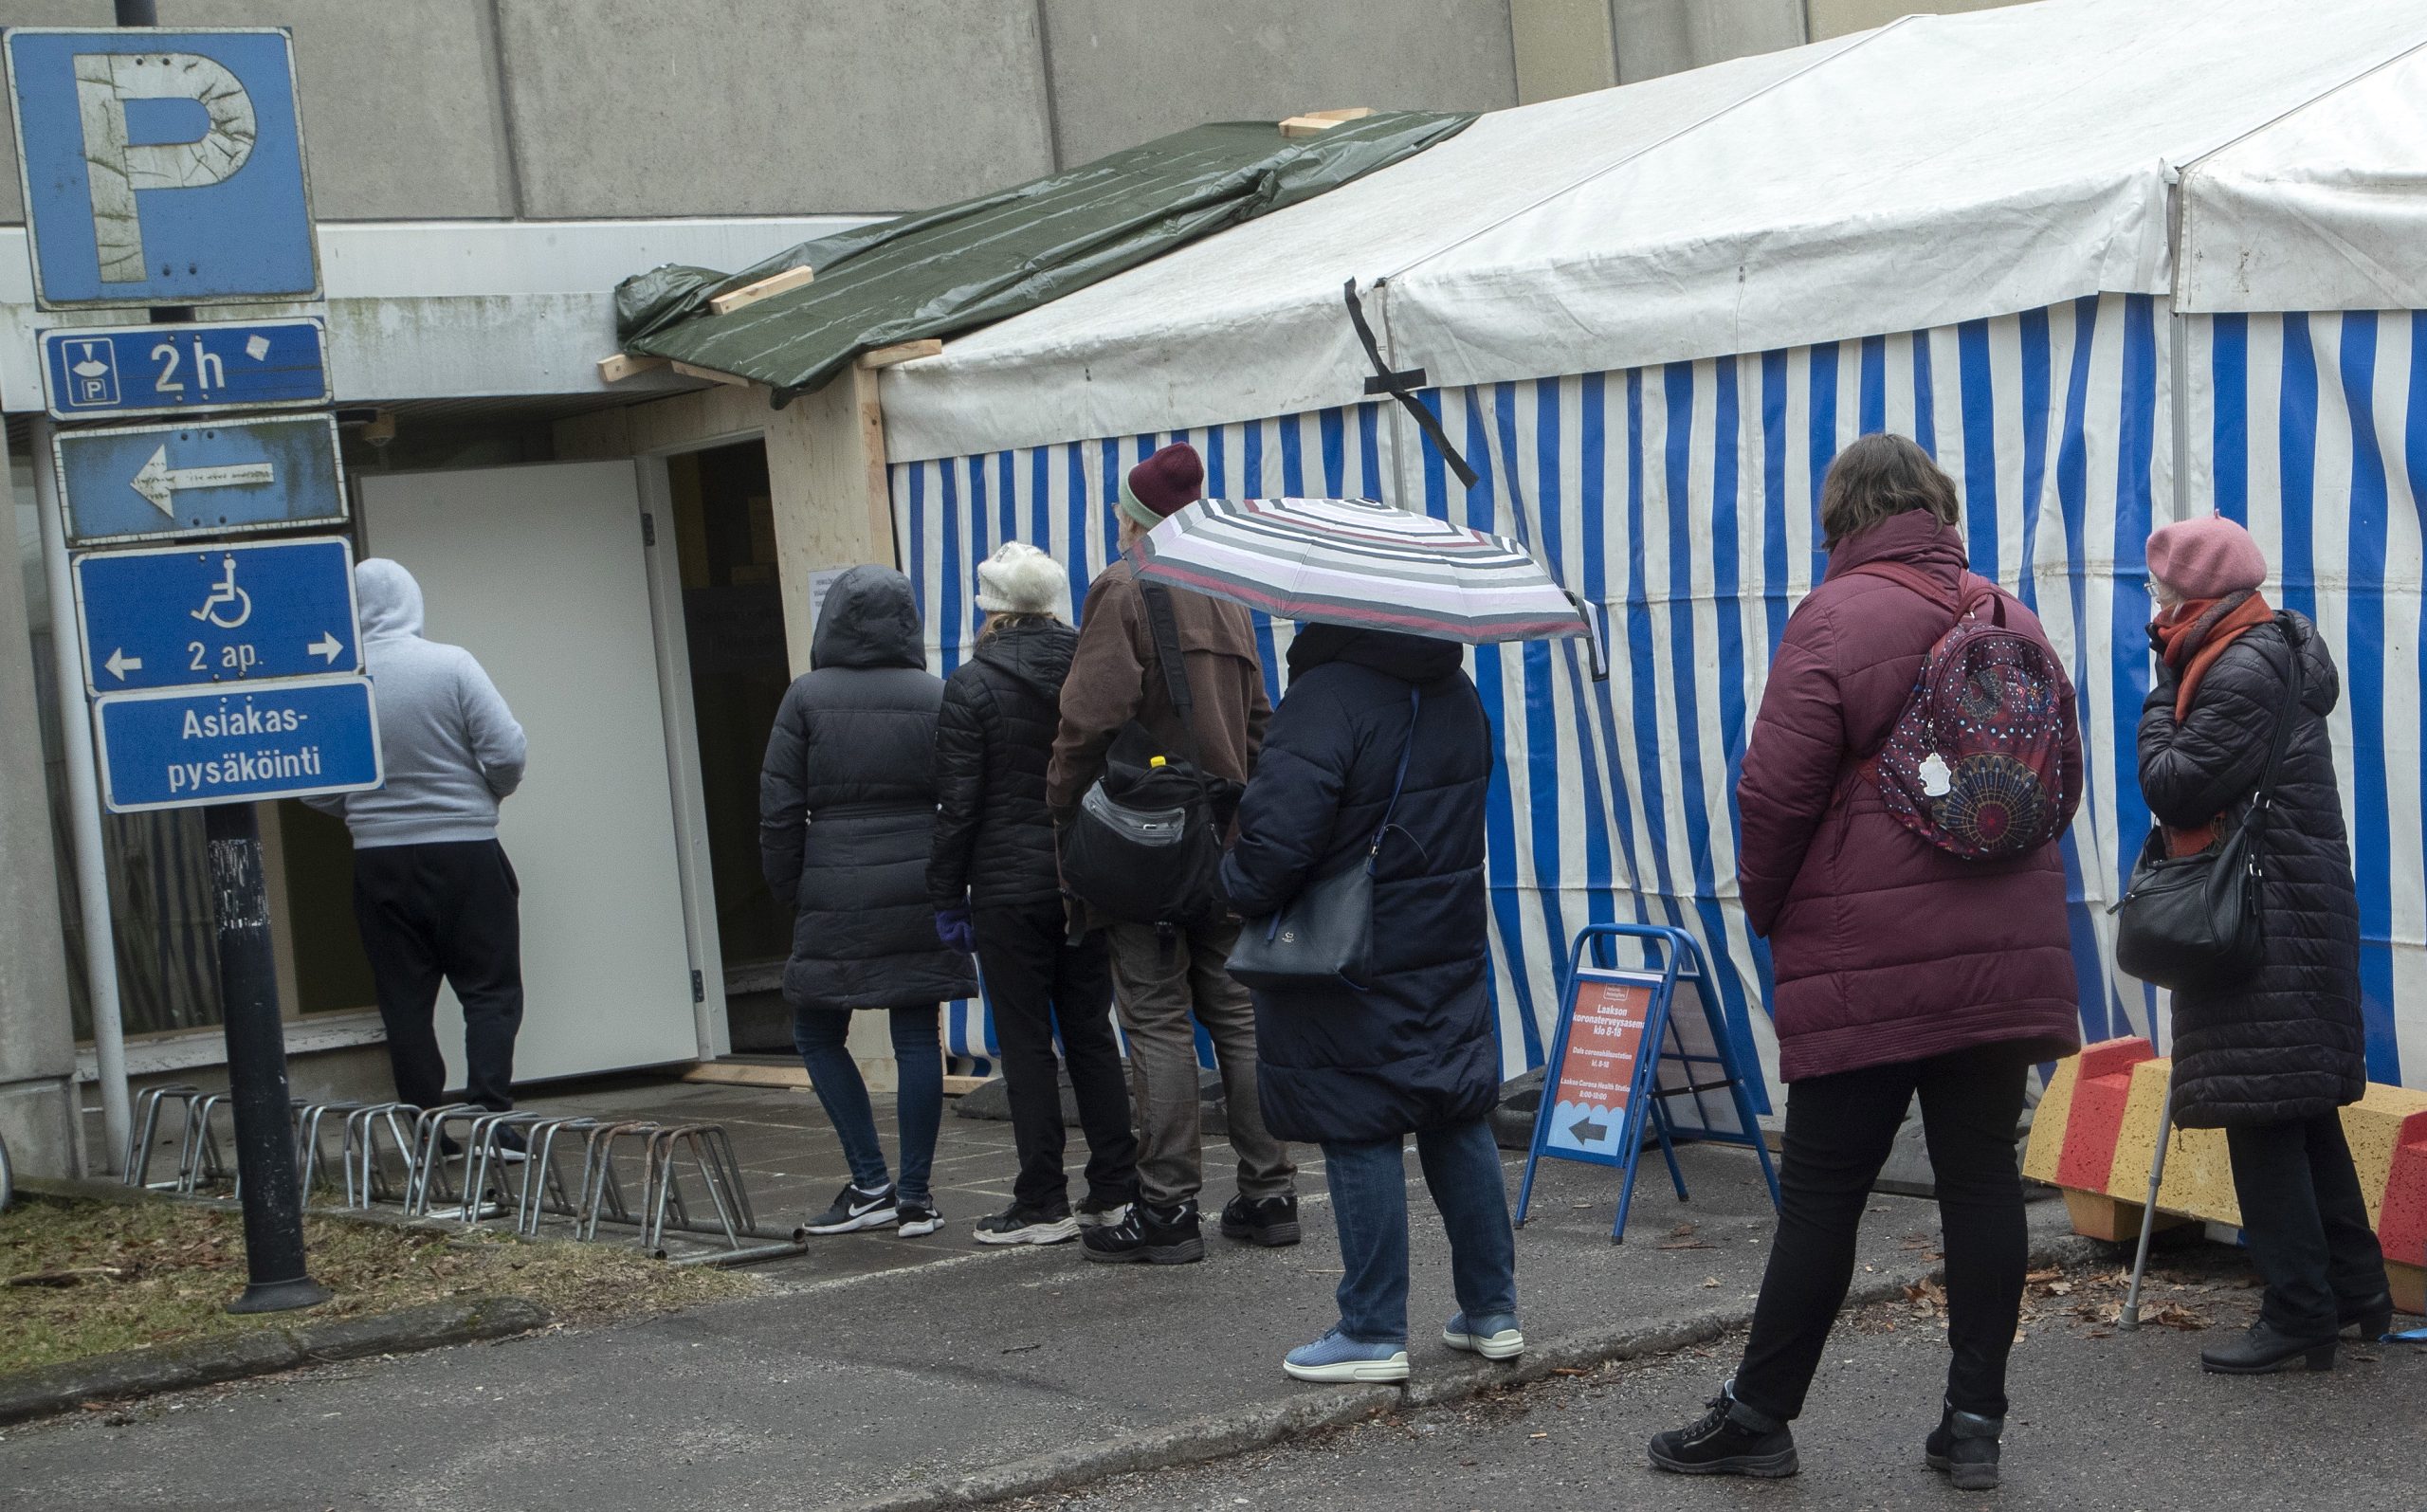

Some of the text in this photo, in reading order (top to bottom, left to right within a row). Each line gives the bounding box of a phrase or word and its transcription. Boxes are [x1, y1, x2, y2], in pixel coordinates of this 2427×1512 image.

[73, 53, 257, 282] P
[188, 641, 264, 671] 2 ap.
[182, 705, 308, 739] Asiakas-
[168, 747, 321, 792] pysäköinti
[1597, 1004, 1628, 1016] Laakson
[1593, 1025, 1622, 1037] klo 8-18
[1597, 1082, 1615, 1091] Health
